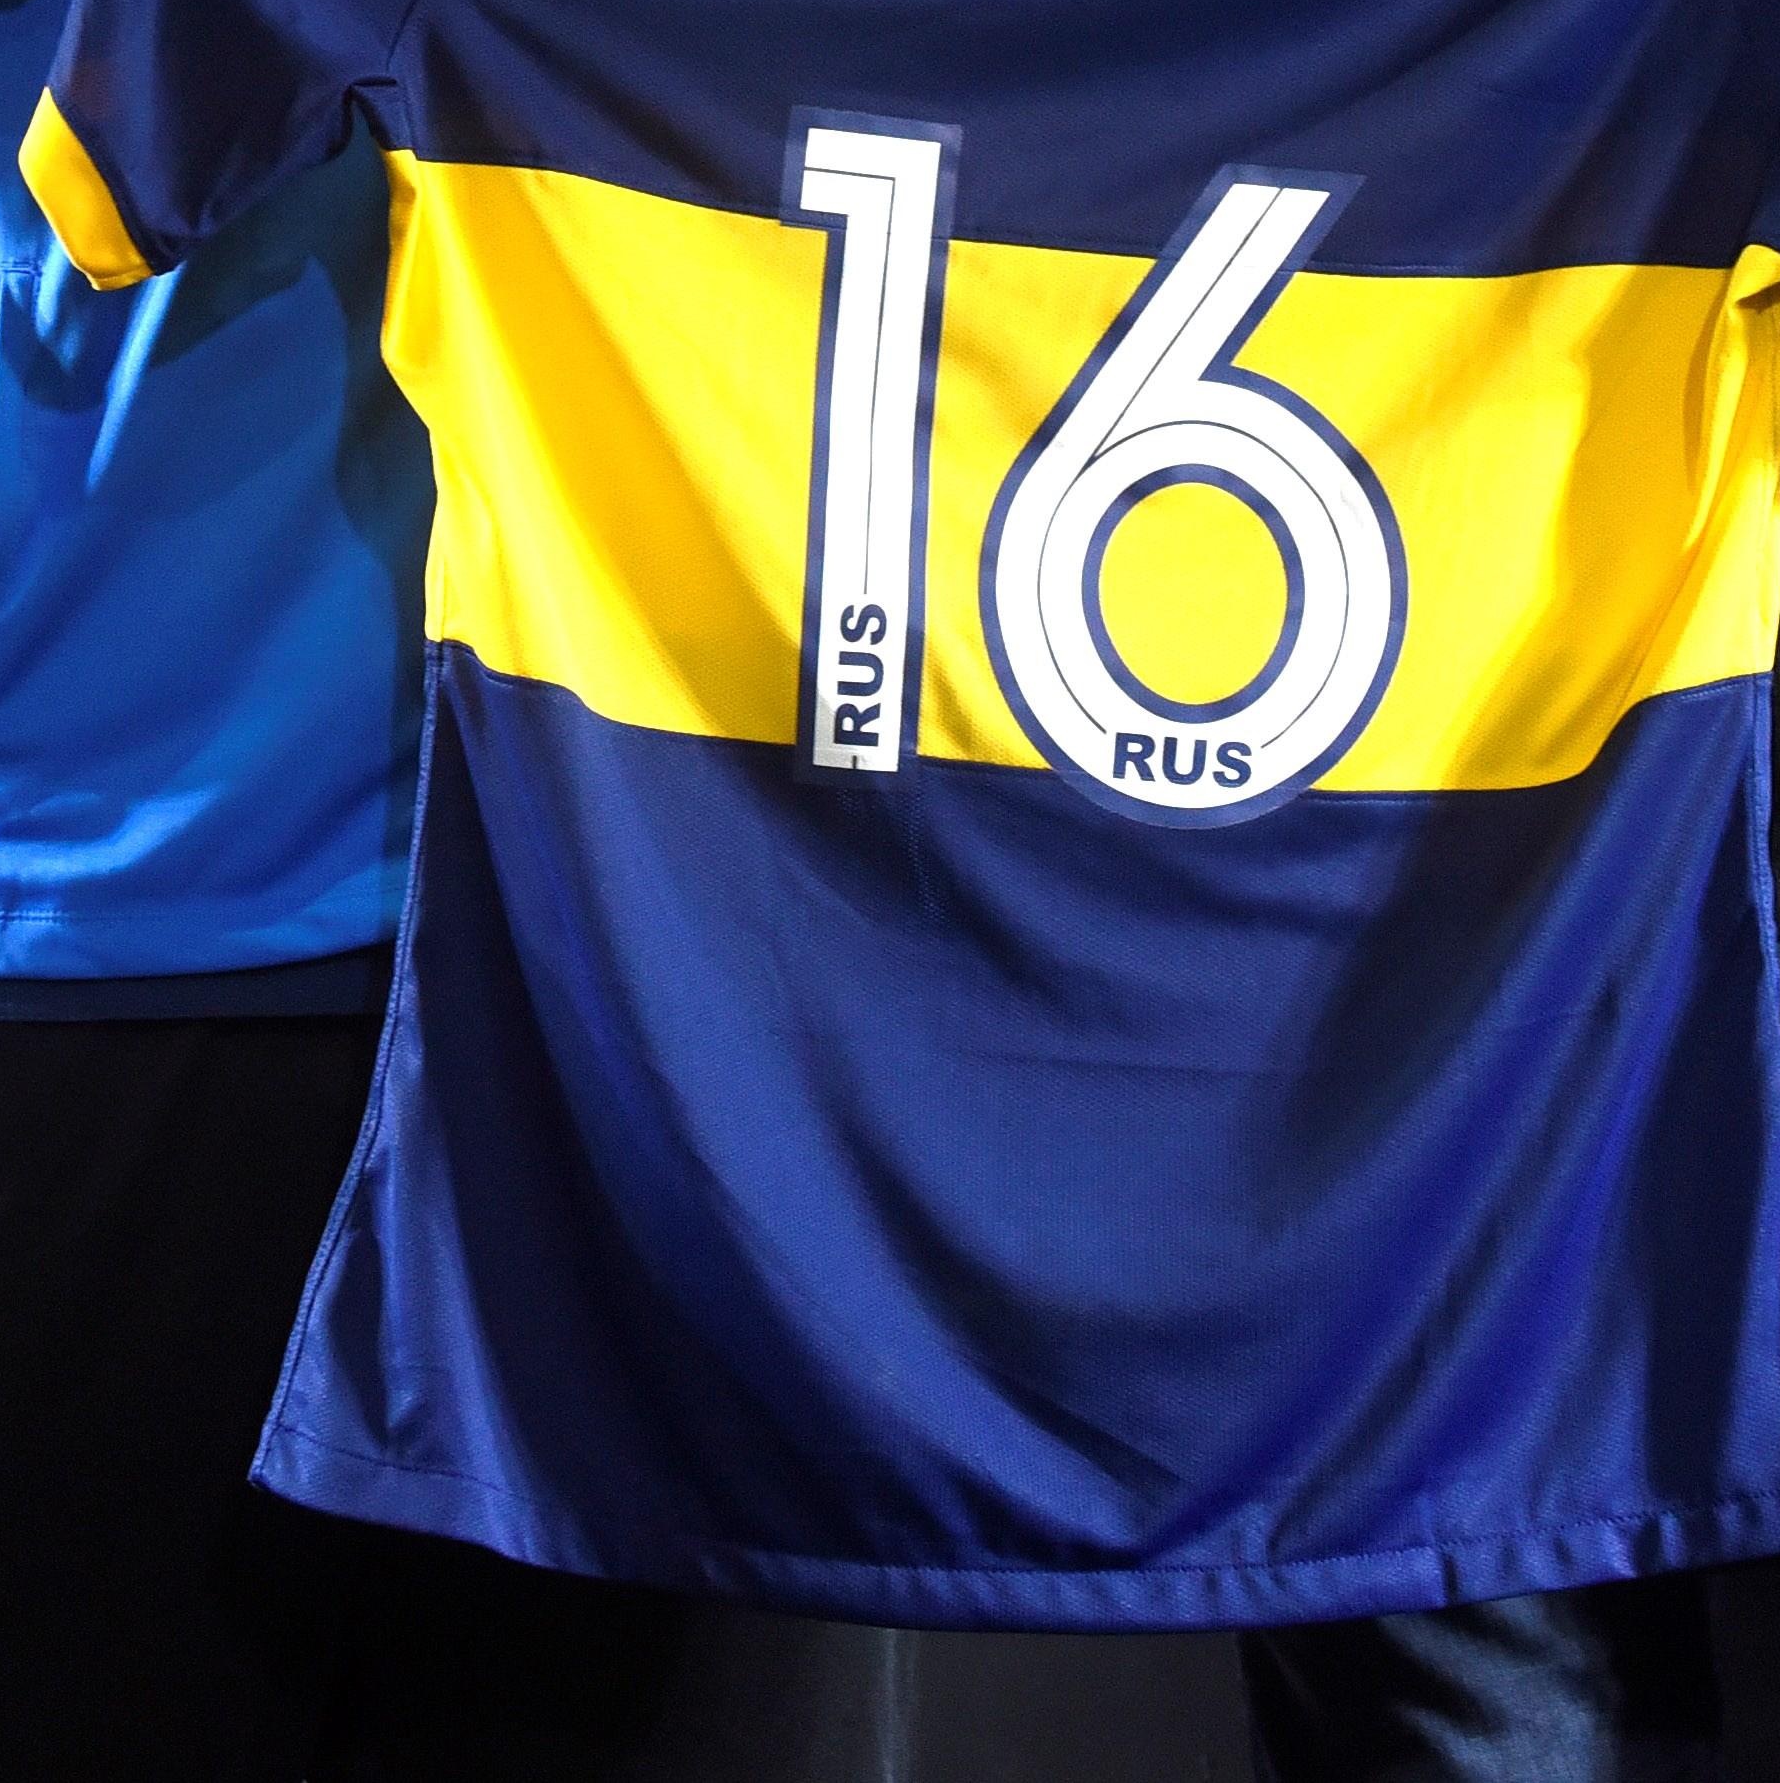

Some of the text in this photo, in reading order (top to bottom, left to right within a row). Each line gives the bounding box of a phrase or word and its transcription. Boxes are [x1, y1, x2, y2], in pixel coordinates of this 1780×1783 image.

[799, 127, 1395, 809] 16
[833, 603, 888, 747] RUS
[1112, 732, 1252, 788] RUS
